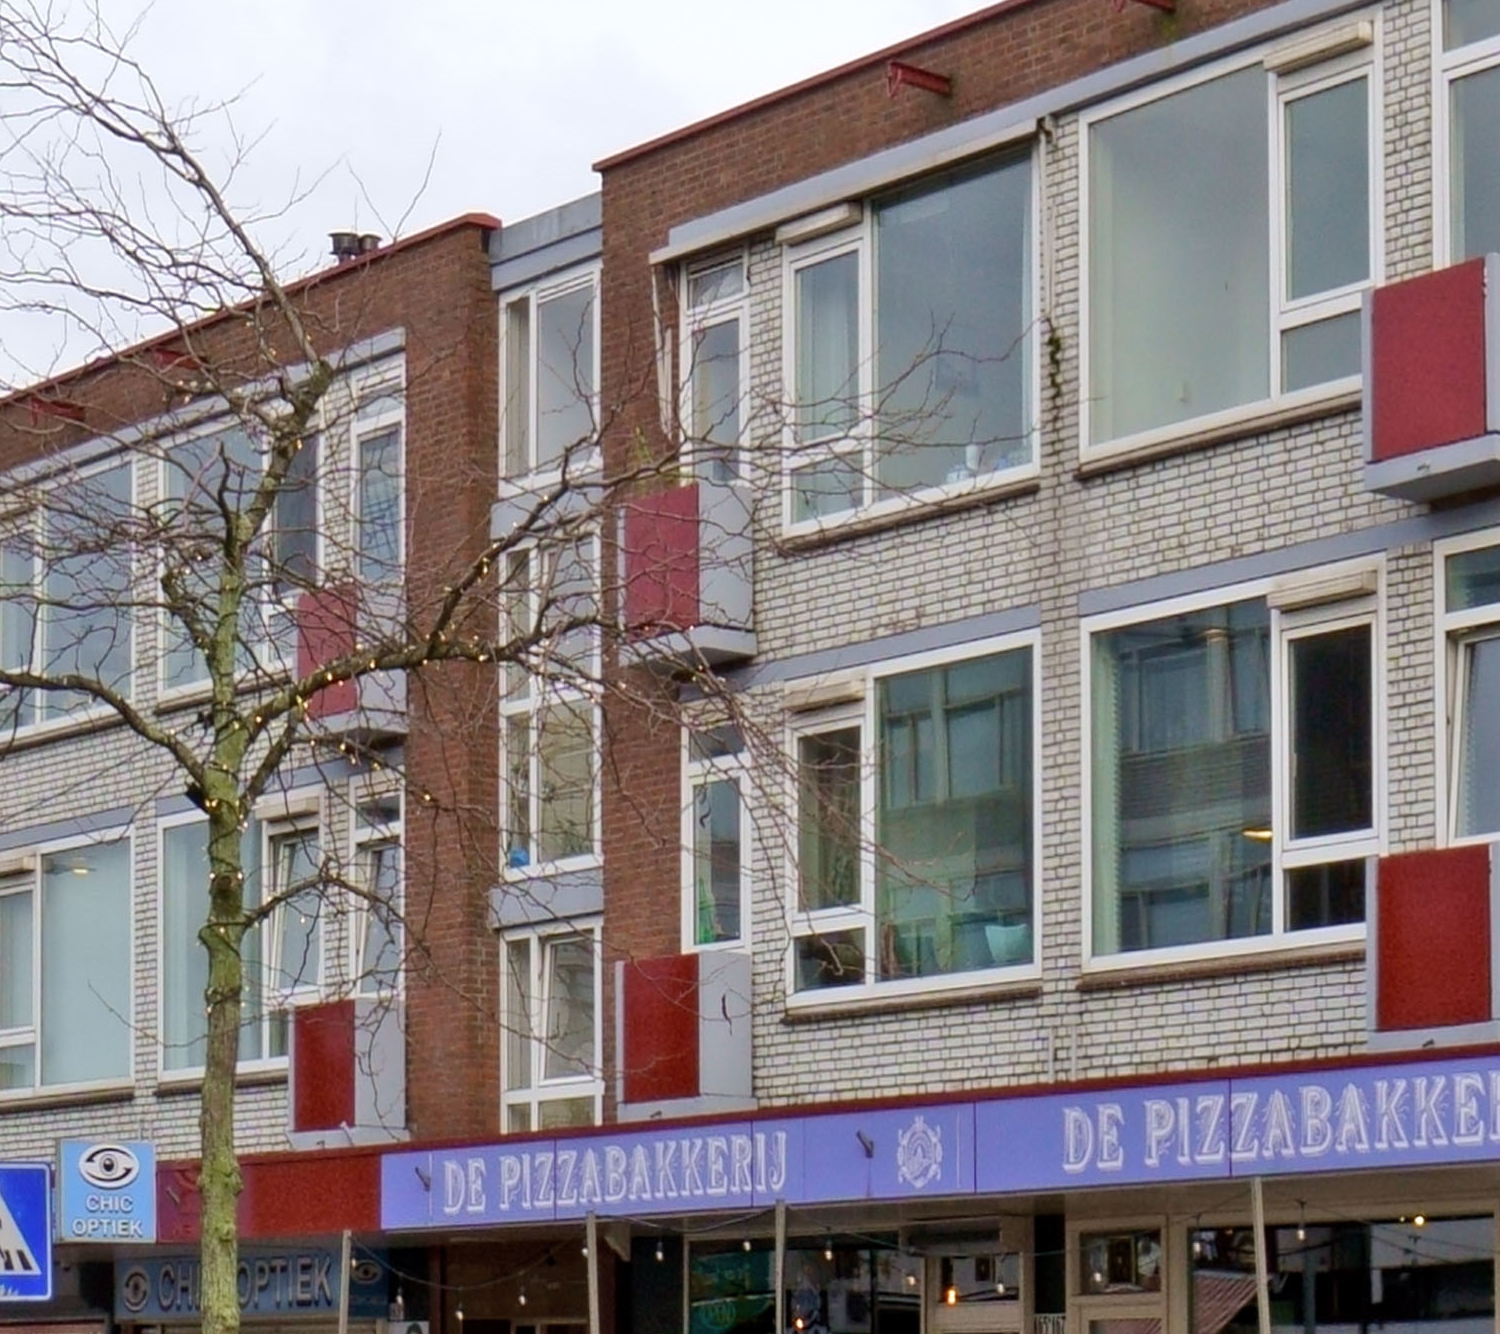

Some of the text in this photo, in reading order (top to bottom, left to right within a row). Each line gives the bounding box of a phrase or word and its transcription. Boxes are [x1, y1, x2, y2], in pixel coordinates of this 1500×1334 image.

[1063, 1105, 1124, 1172] DE
[443, 1130, 787, 1215] DE PIZZABAKKERIJ
[71, 1219, 144, 1238] OPTIEK
[86, 1194, 133, 1214] CHIC
[157, 1262, 202, 1312] CHI
